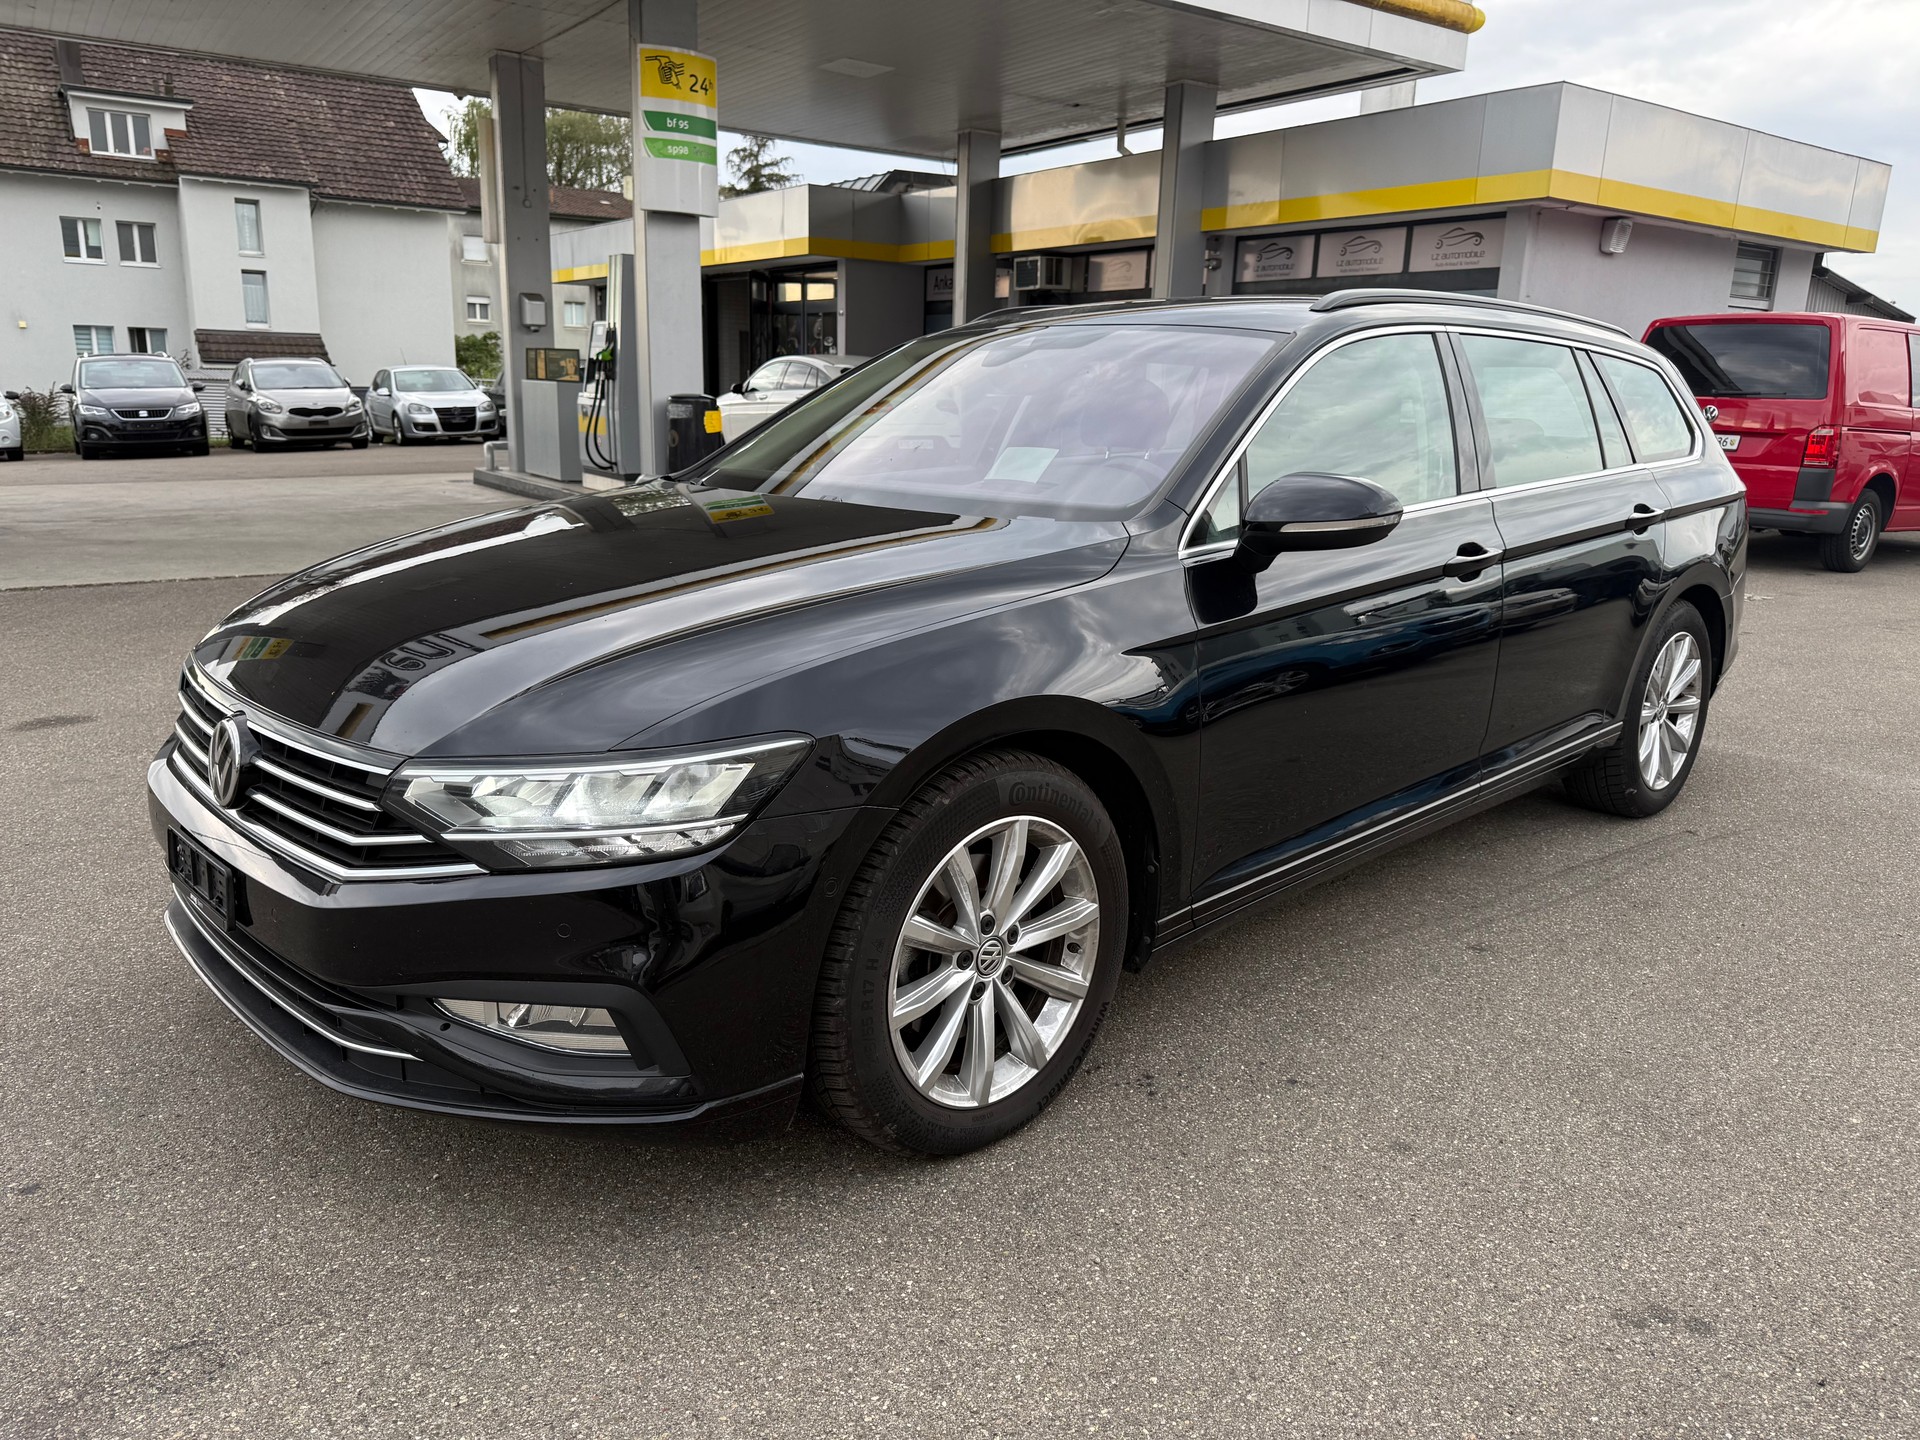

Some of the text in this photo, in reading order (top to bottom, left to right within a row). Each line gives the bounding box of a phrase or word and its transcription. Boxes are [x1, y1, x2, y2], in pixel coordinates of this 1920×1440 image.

[667, 117, 689, 129] bf 95
[667, 145, 689, 155] sp98
[1441, 250, 1485, 260] automobile
[1009, 781, 1095, 822] Continental
